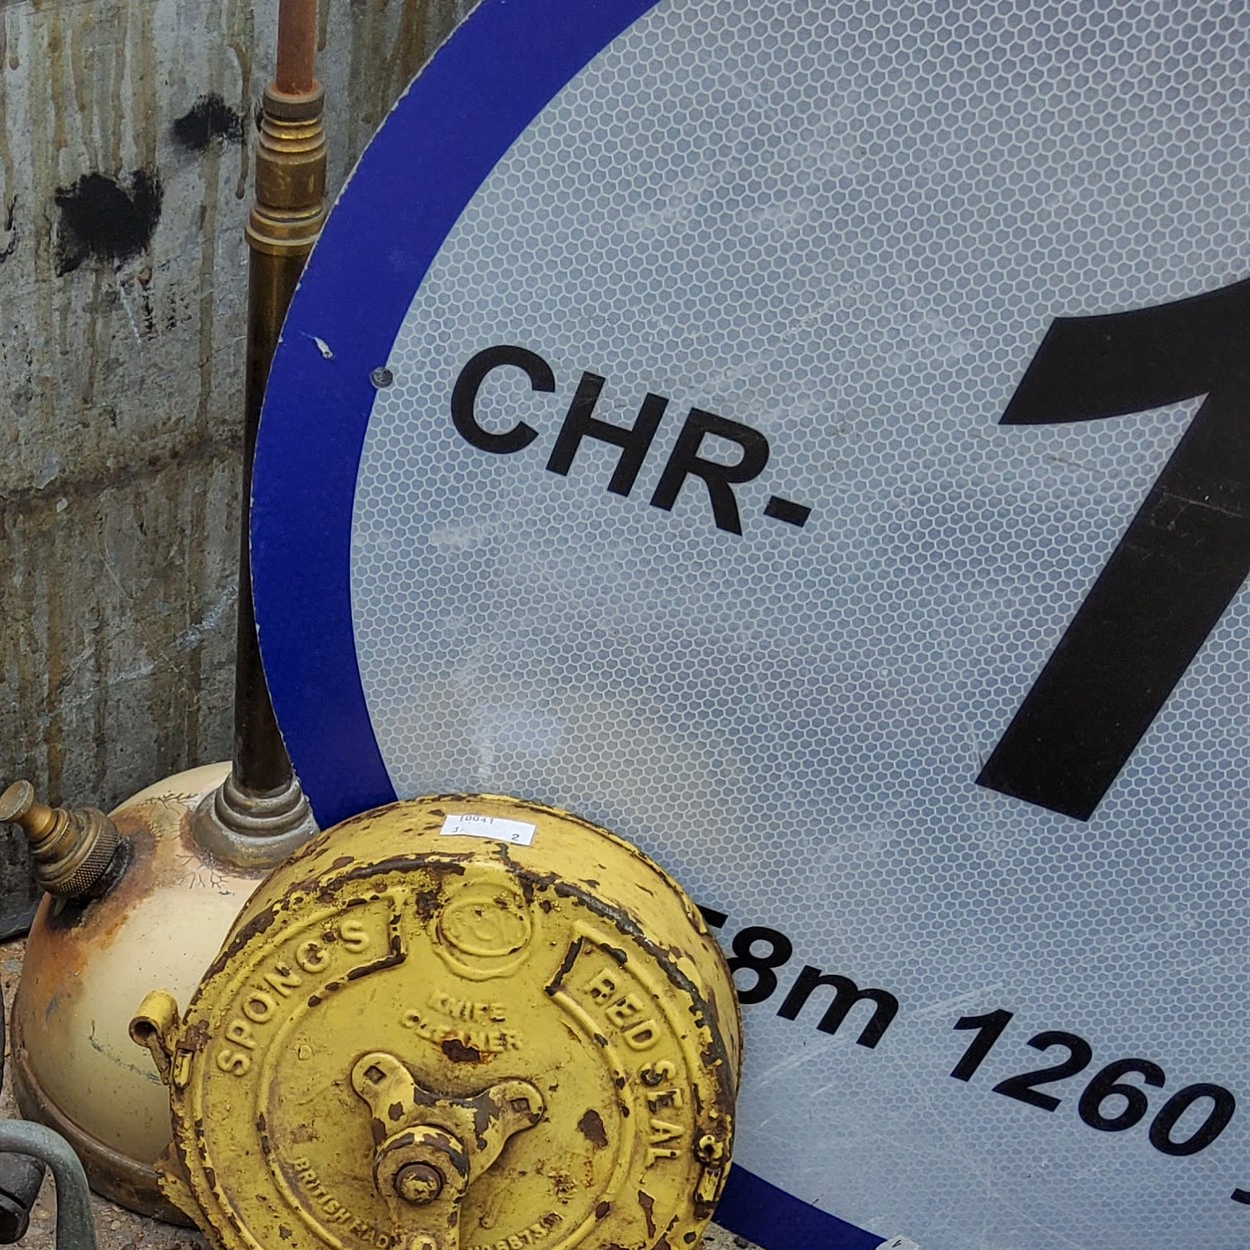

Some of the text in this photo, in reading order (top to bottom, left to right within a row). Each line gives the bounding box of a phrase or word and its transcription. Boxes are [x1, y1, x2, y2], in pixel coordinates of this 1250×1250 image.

[450, 344, 813, 536] CHR-
[583, 966, 685, 1170] RED SEAL
[694, 902, 1237, 1157] 8m 1260
[292, 1156, 352, 1224] BRITISH
